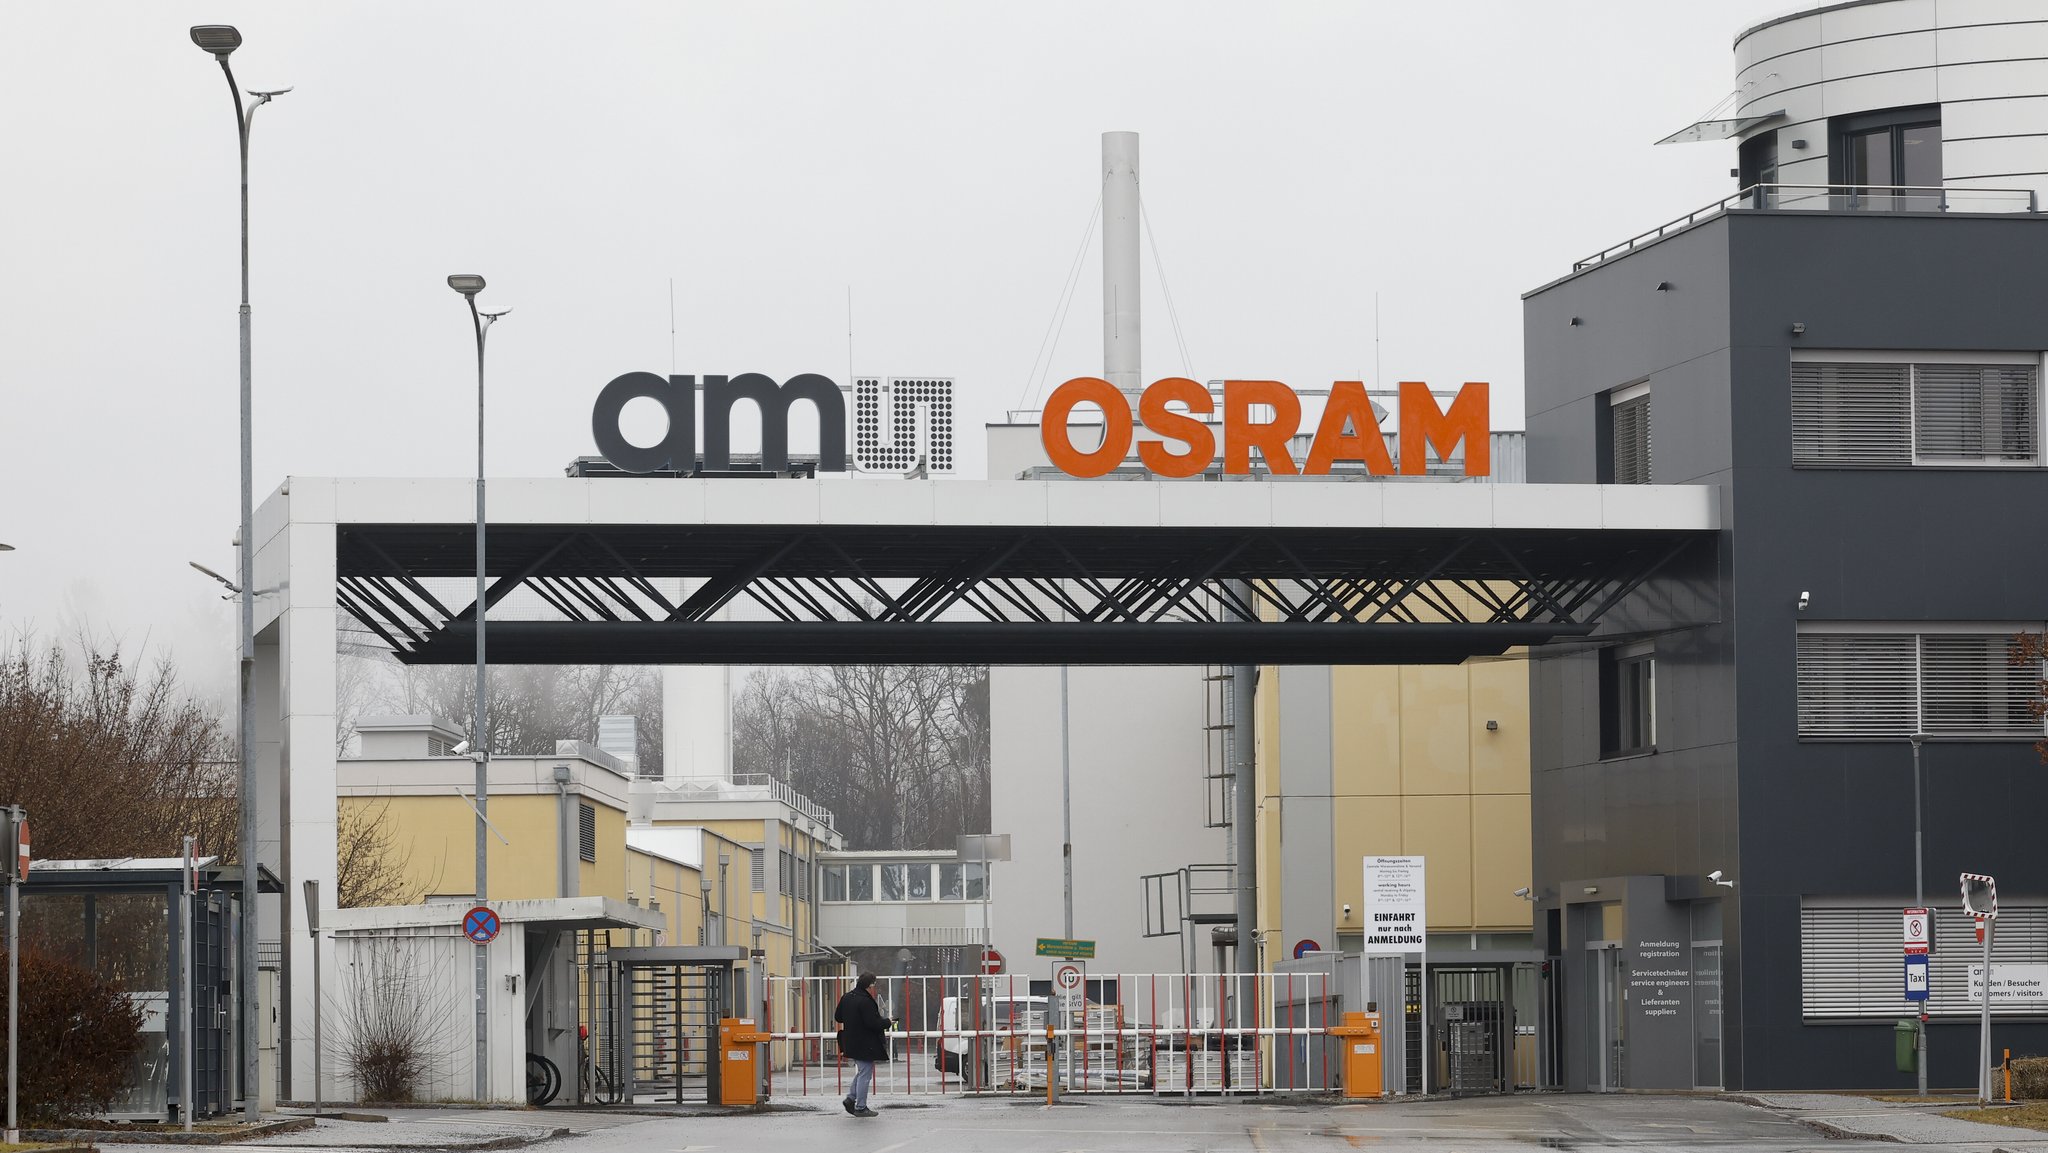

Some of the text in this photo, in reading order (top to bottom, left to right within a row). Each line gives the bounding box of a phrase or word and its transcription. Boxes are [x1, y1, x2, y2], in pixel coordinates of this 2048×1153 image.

[1041, 377, 1490, 478] OSRAM
[1374, 913, 1415, 921] EINFAHRT
[1394, 924, 1412, 932] nach
[1368, 935, 1422, 944] ANMELDUNG
[1640, 940, 1680, 949] Anmeldung
[1640, 950, 1680, 958] registration
[1063, 971, 1075, 983] 10
[1631, 969, 1689, 977] Servicetechniker
[1909, 972, 1925, 982] Taxi
[2007, 979, 2041, 987] Besucher
[1645, 1008, 1677, 1016] suppliers
